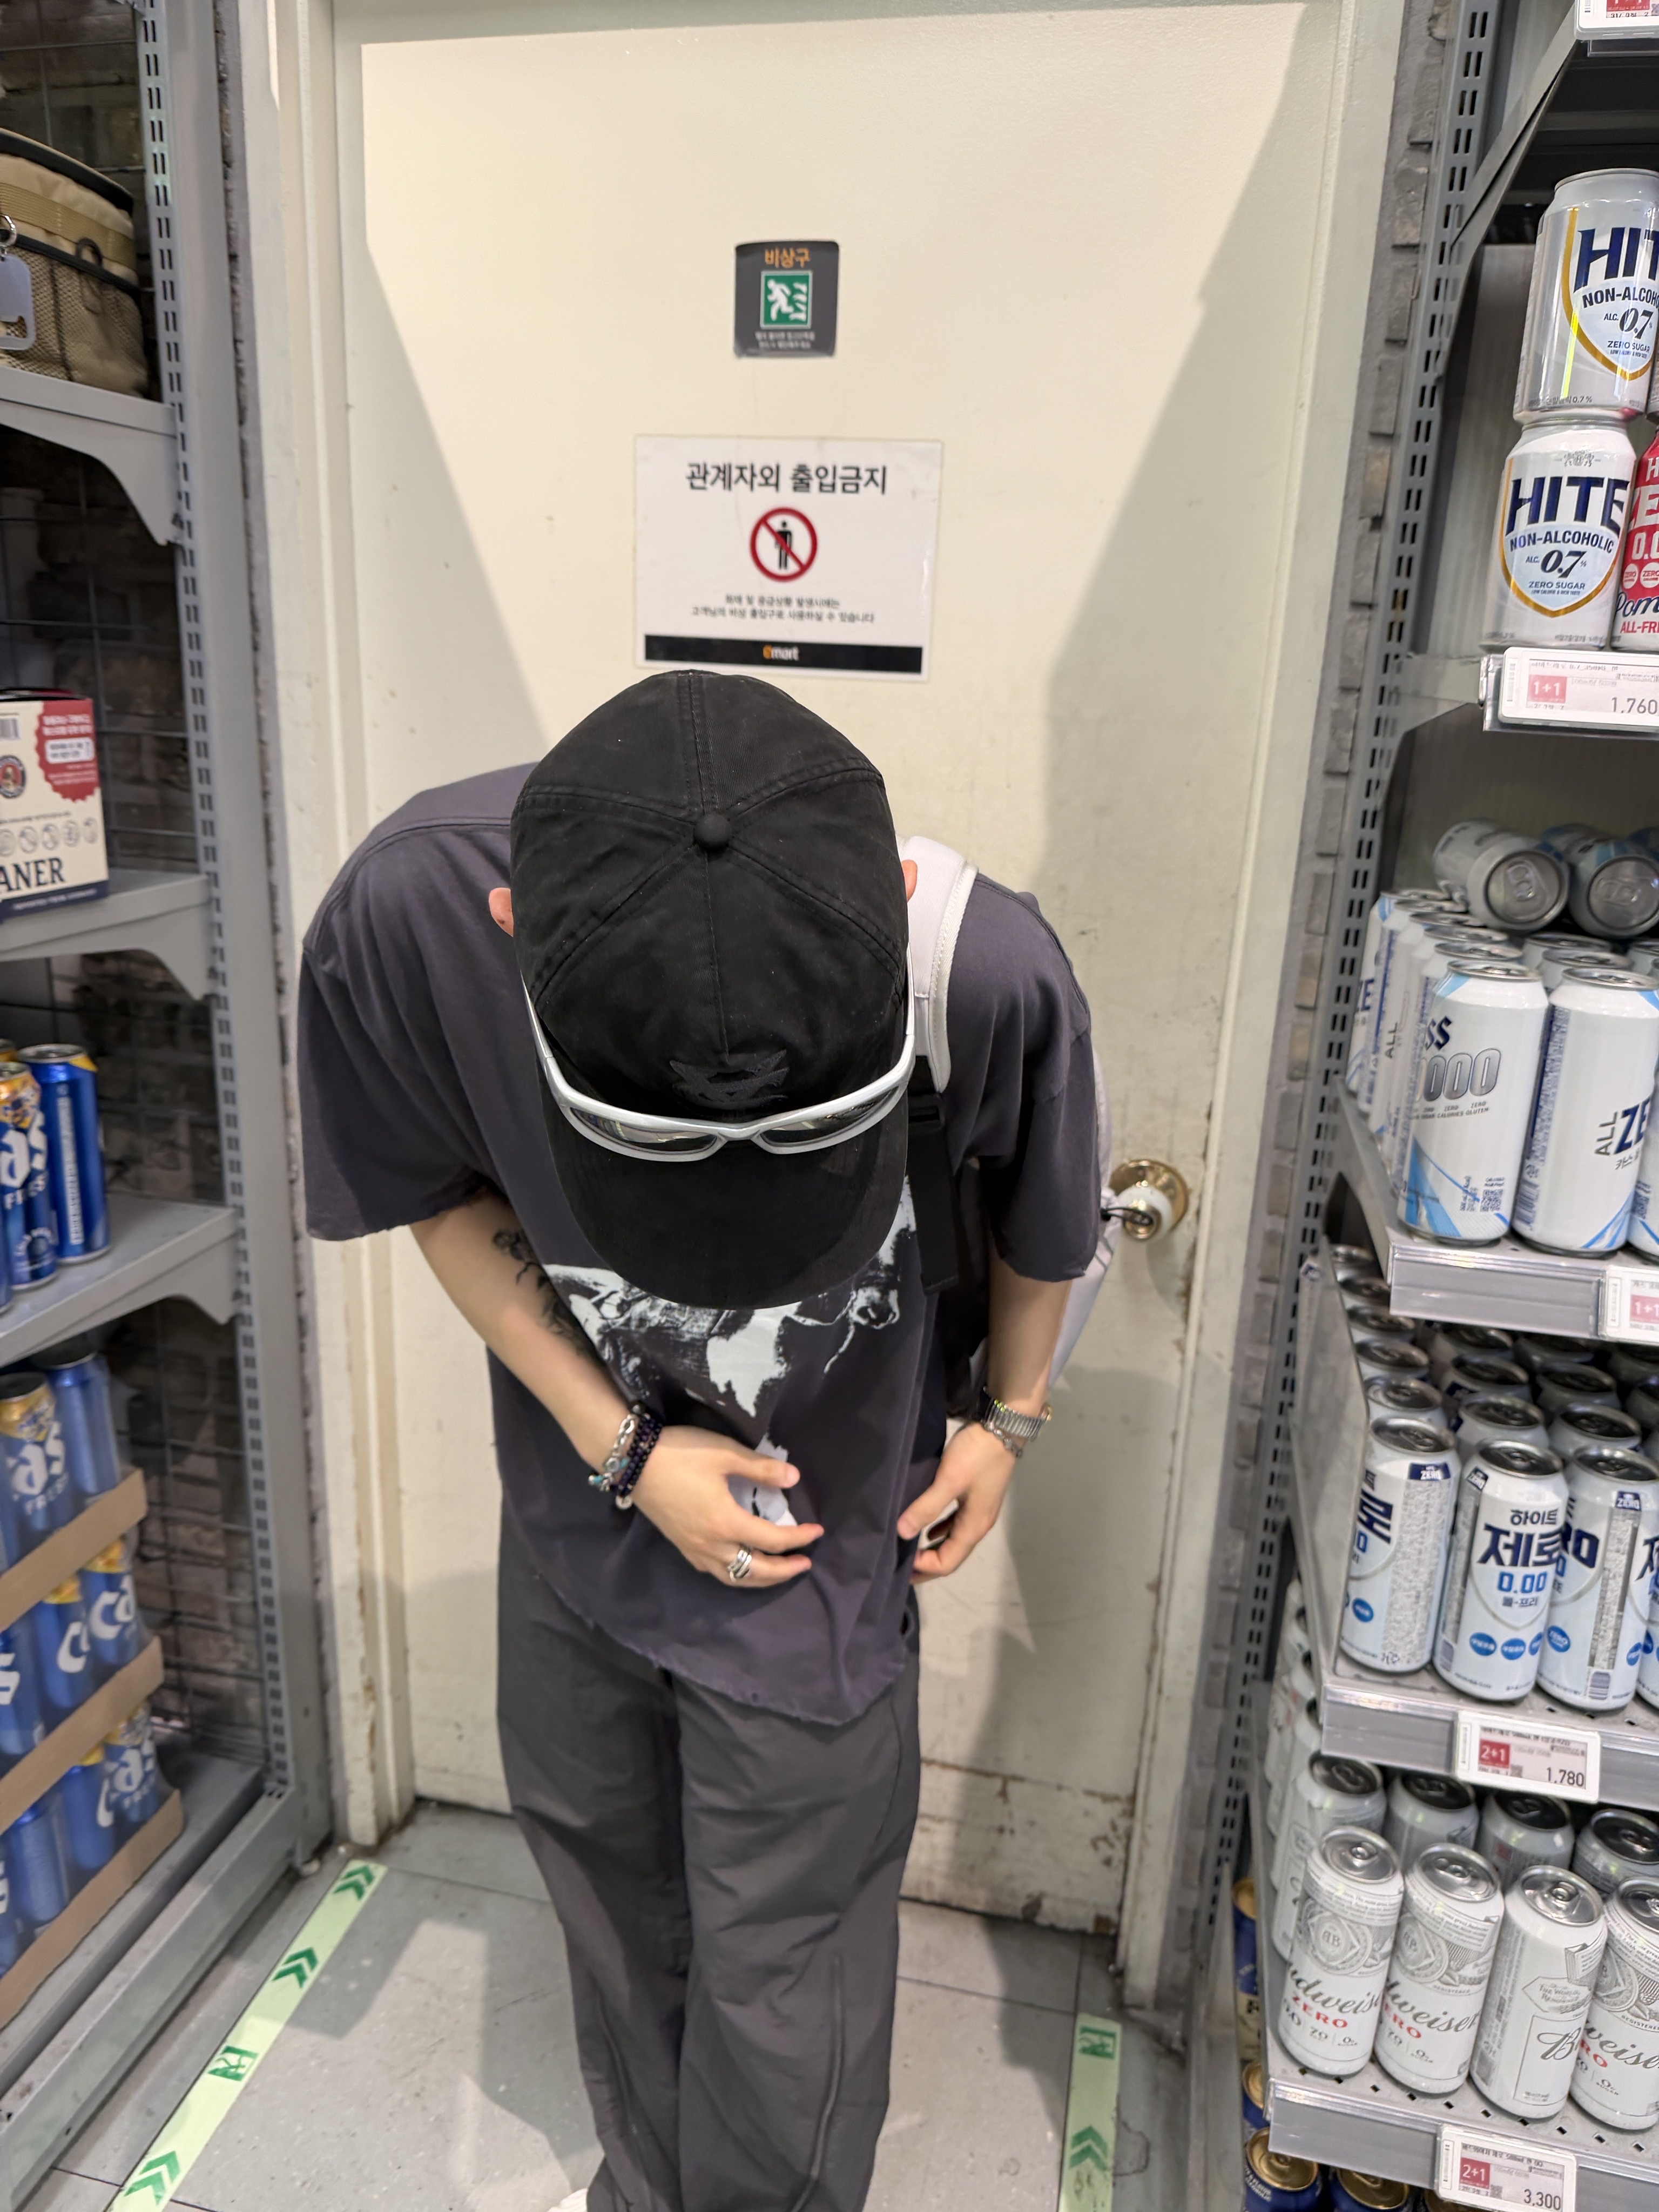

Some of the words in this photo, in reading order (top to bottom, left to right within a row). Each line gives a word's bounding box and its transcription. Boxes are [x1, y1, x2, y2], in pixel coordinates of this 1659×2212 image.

[765, 247, 811, 268] 비상구
[686, 462, 780, 493] 관계자외
[790, 464, 886, 495] 출입금지
[1505, 476, 1630, 539] HITE
[1510, 530, 1614, 554] NON-ALCOHOLIC
[1555, 582, 1586, 590] SUGAR
[1620, 621, 1659, 633] ALL-FR
[1510, 1509, 1558, 1525] 하이트
[1498, 1571, 1547, 1594] 0.00
[1462, 2163, 1485, 2181] 2+1
